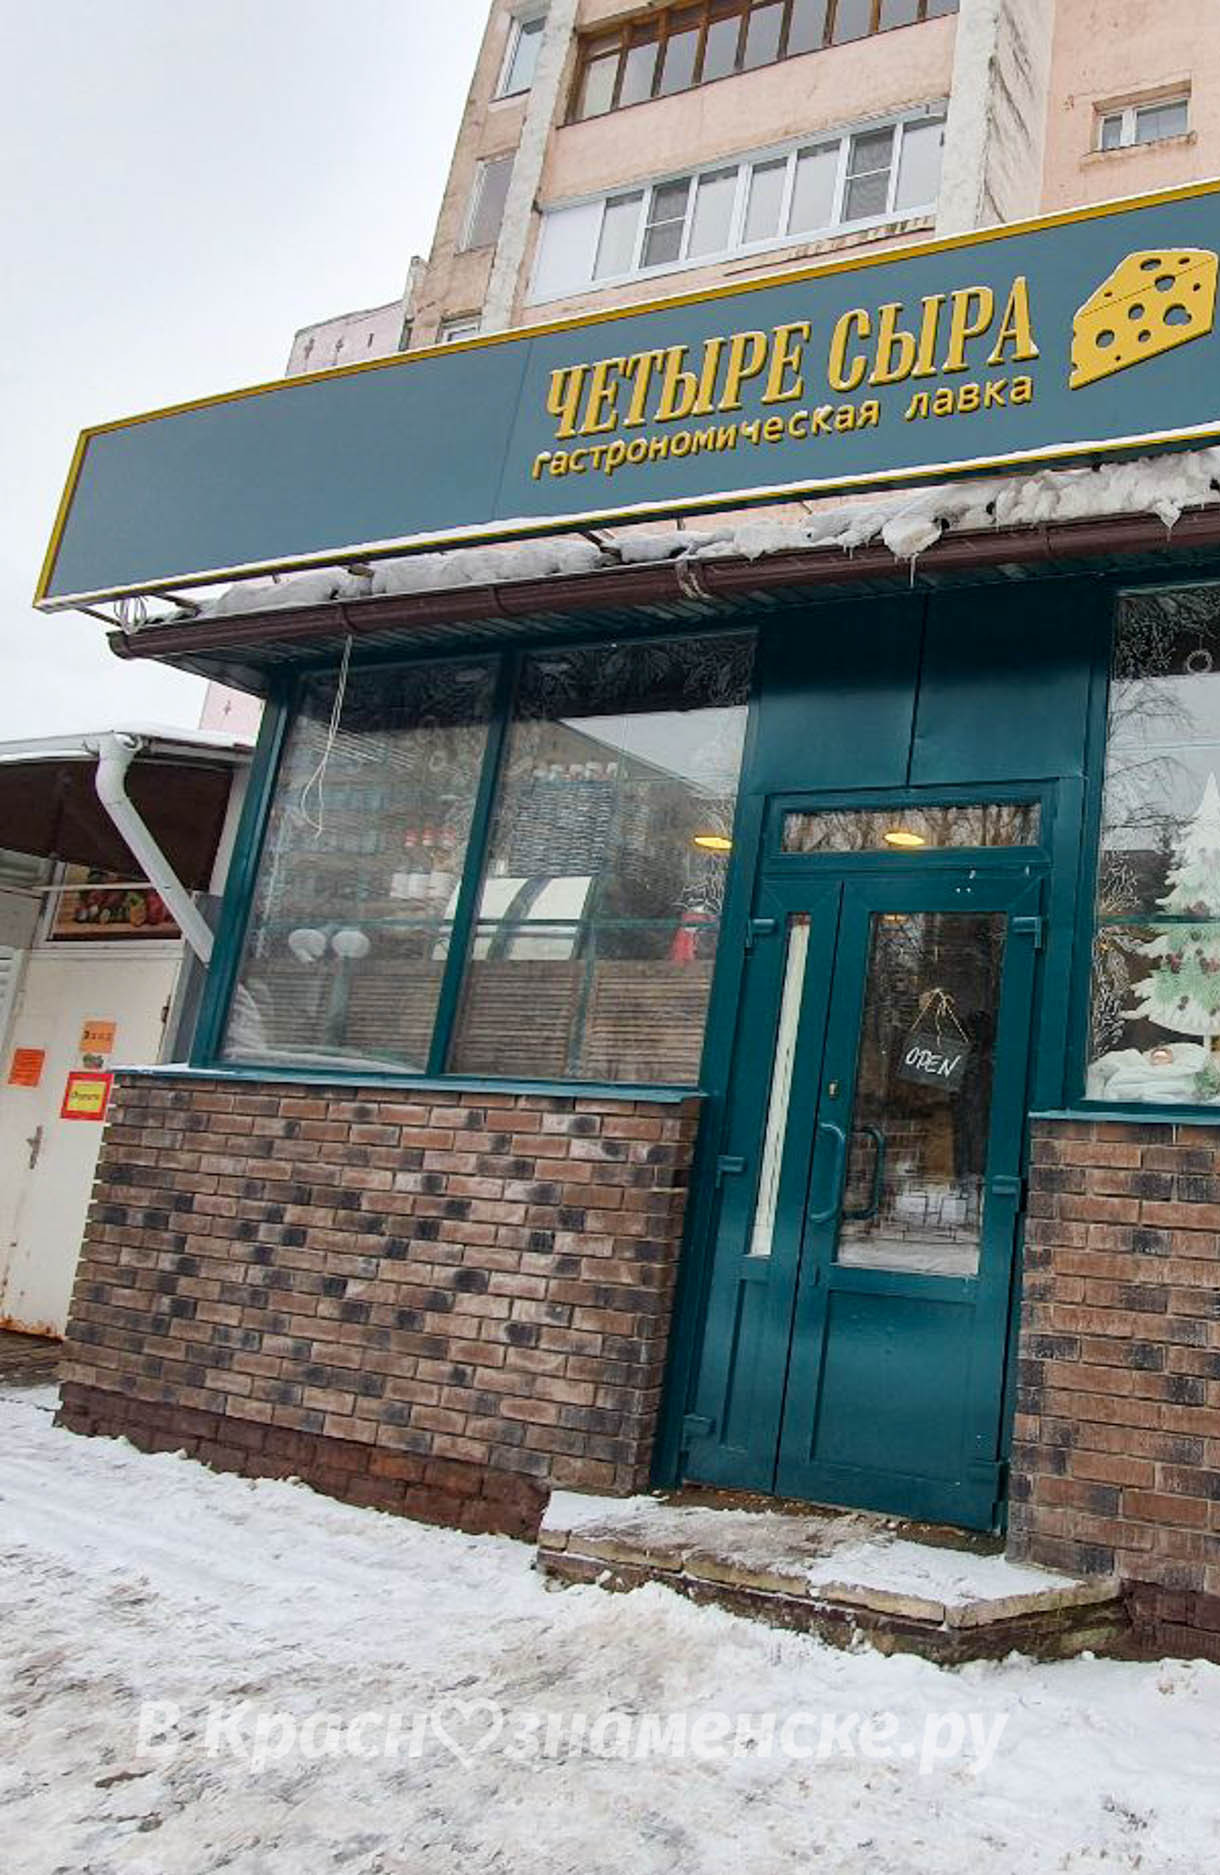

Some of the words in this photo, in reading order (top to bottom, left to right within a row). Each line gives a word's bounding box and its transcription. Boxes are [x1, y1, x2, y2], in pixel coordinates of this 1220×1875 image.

[547, 320, 812, 440] ЧЕТЫРЕ
[828, 275, 1040, 392] СЫРА
[531, 400, 880, 480] гастрономическая
[904, 375, 1034, 421] лавка
[905, 1047, 961, 1077] OPEN
